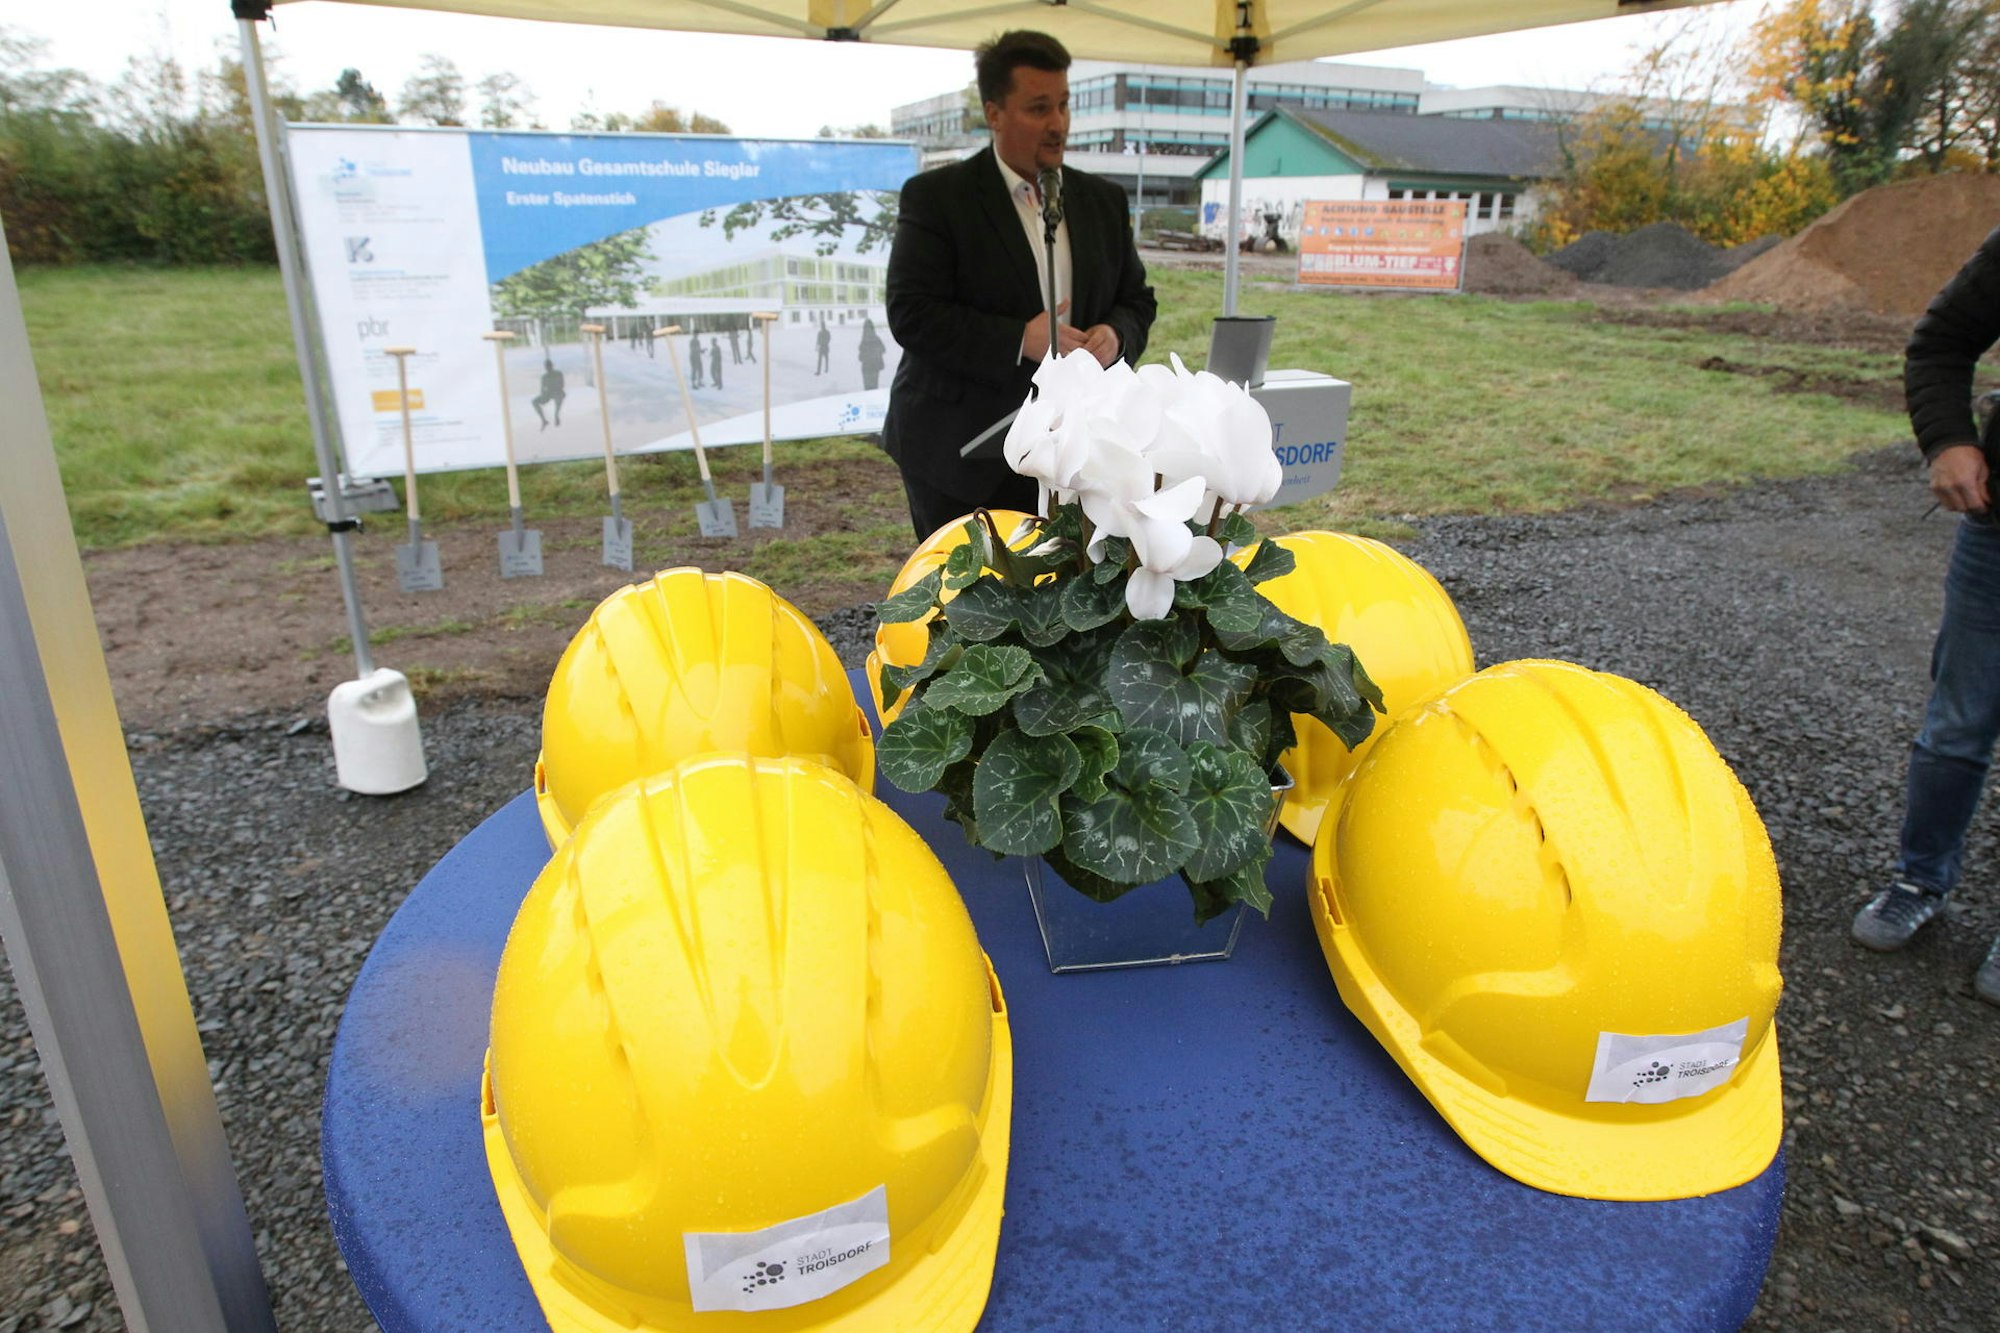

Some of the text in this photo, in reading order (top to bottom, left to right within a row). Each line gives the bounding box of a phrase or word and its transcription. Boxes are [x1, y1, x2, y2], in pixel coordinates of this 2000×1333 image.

[501, 157, 760, 180] Neubau Gesamtschule Sieglar
[506, 191, 636, 208] Erster Spatenstich
[357, 317, 389, 341] pbr
[1275, 442, 1336, 467] SDORF
[797, 1248, 832, 1265] STADT
[798, 1241, 872, 1274] TROISDORF
